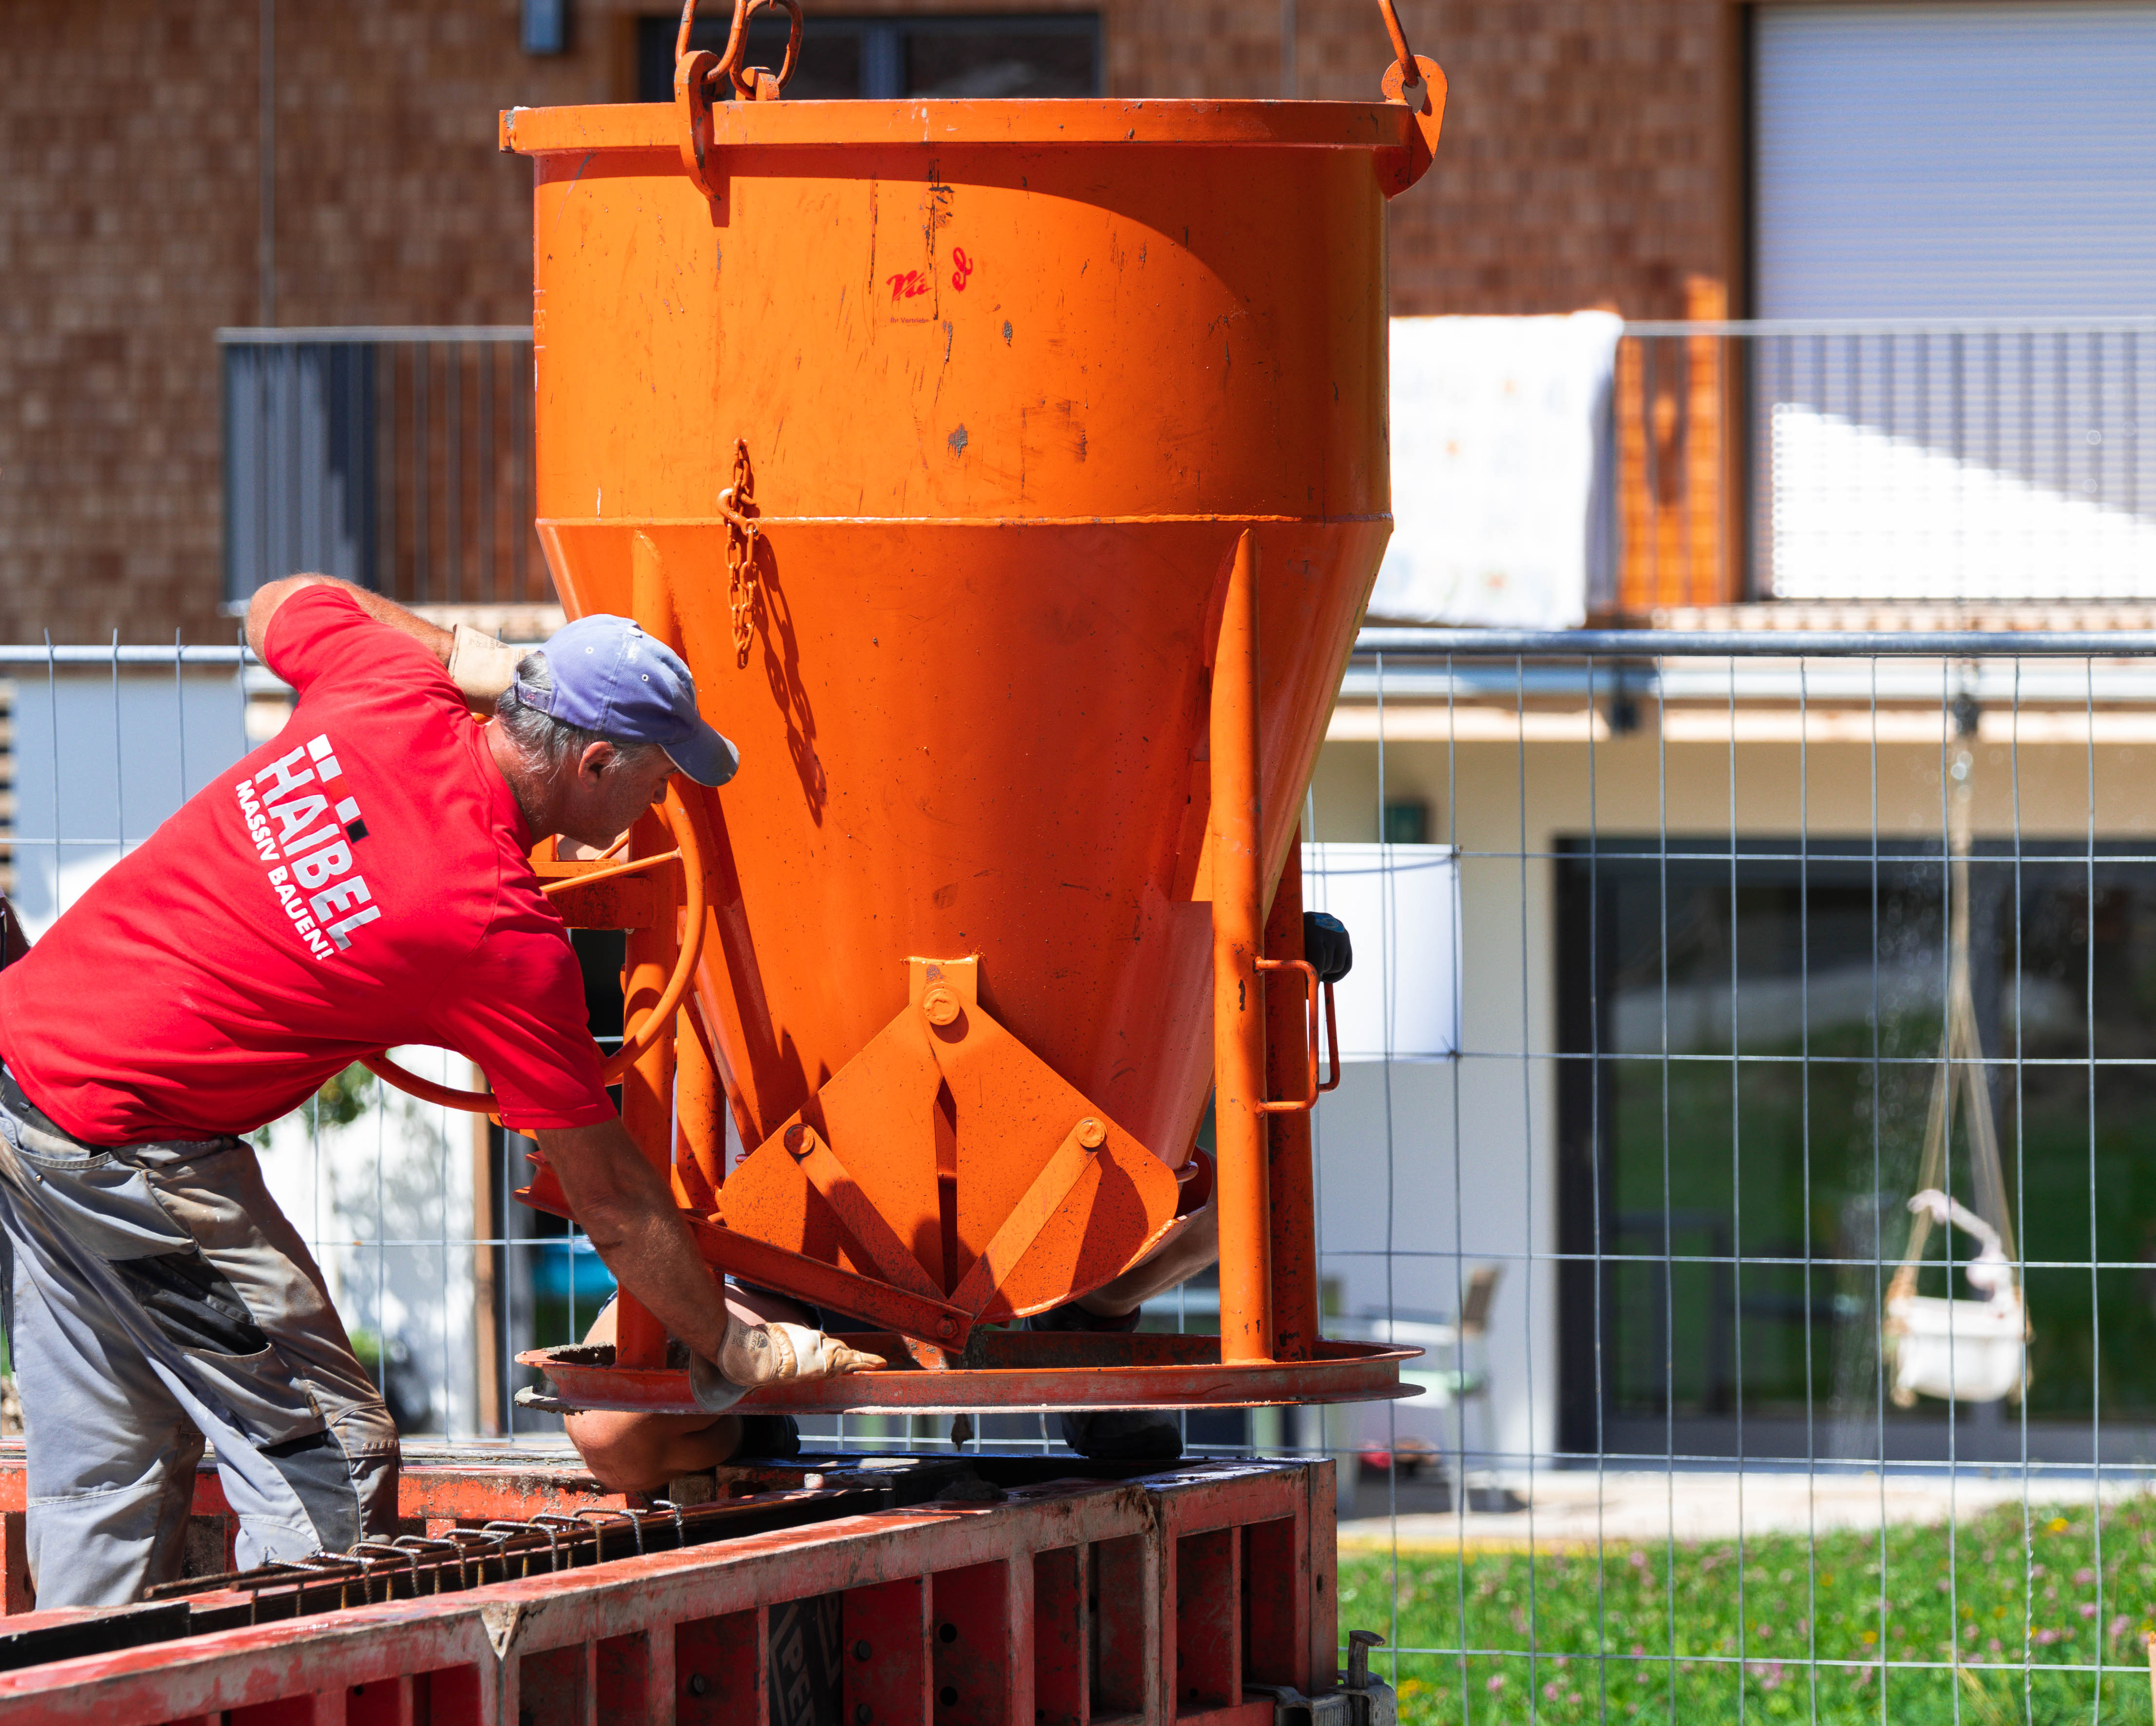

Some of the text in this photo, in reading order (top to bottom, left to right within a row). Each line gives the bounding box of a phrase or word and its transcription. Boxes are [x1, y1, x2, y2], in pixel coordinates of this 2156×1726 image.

[235, 778, 335, 961] MASSIV BAUEN!
[255, 746, 381, 951] HAIBEL
